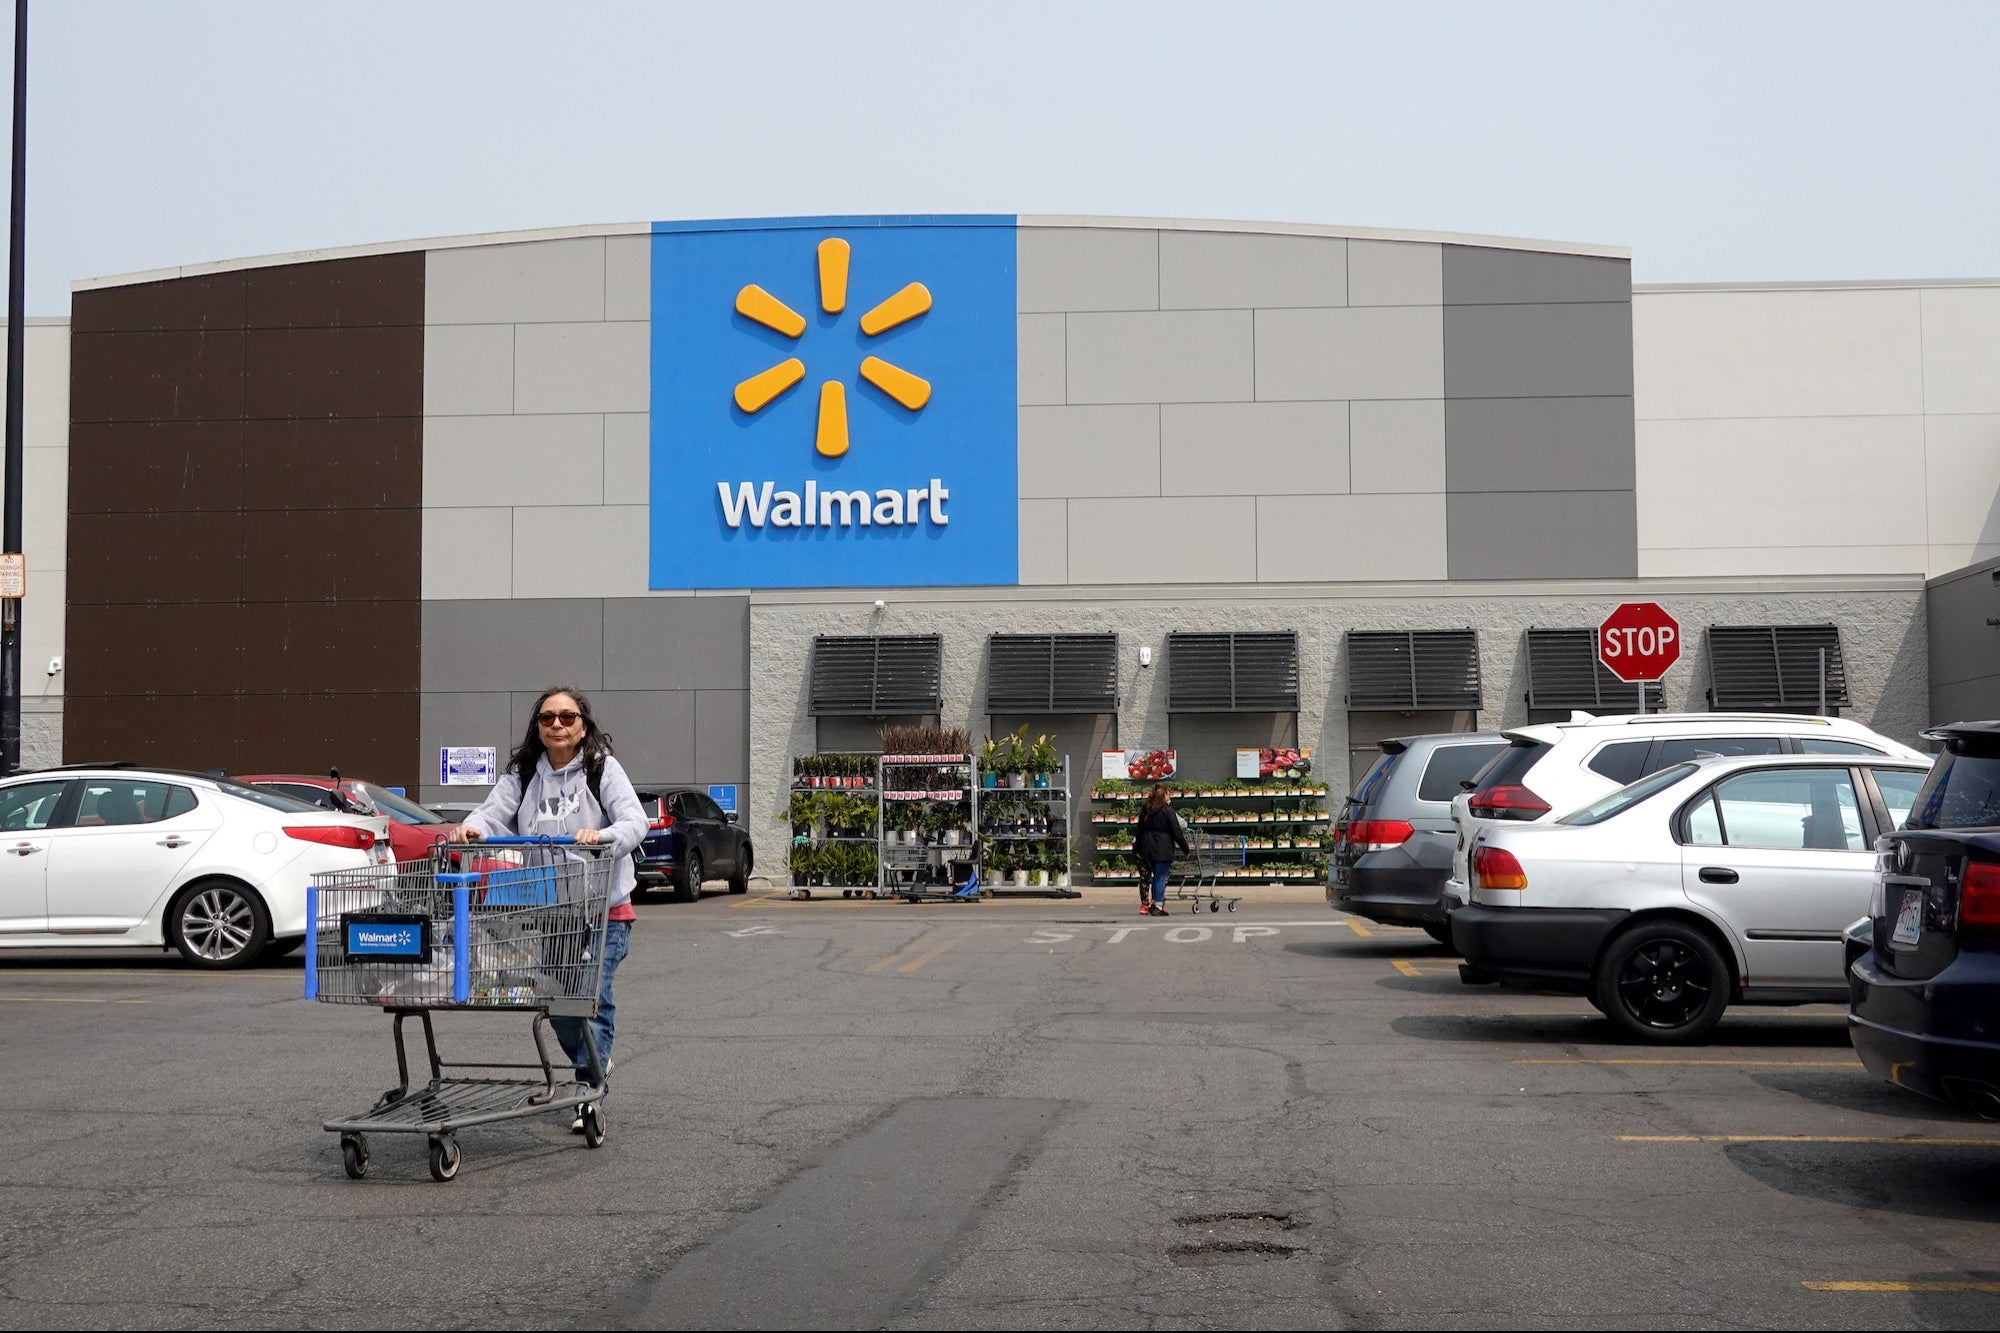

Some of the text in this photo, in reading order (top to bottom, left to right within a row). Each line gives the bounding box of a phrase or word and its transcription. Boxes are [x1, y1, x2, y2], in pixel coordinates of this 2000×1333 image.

[717, 479, 949, 528] Walmart
[1605, 626, 1675, 657] STOP
[721, 788, 724, 798] 1
[359, 932, 397, 942] Walmart
[1022, 926, 1280, 944] STOP
